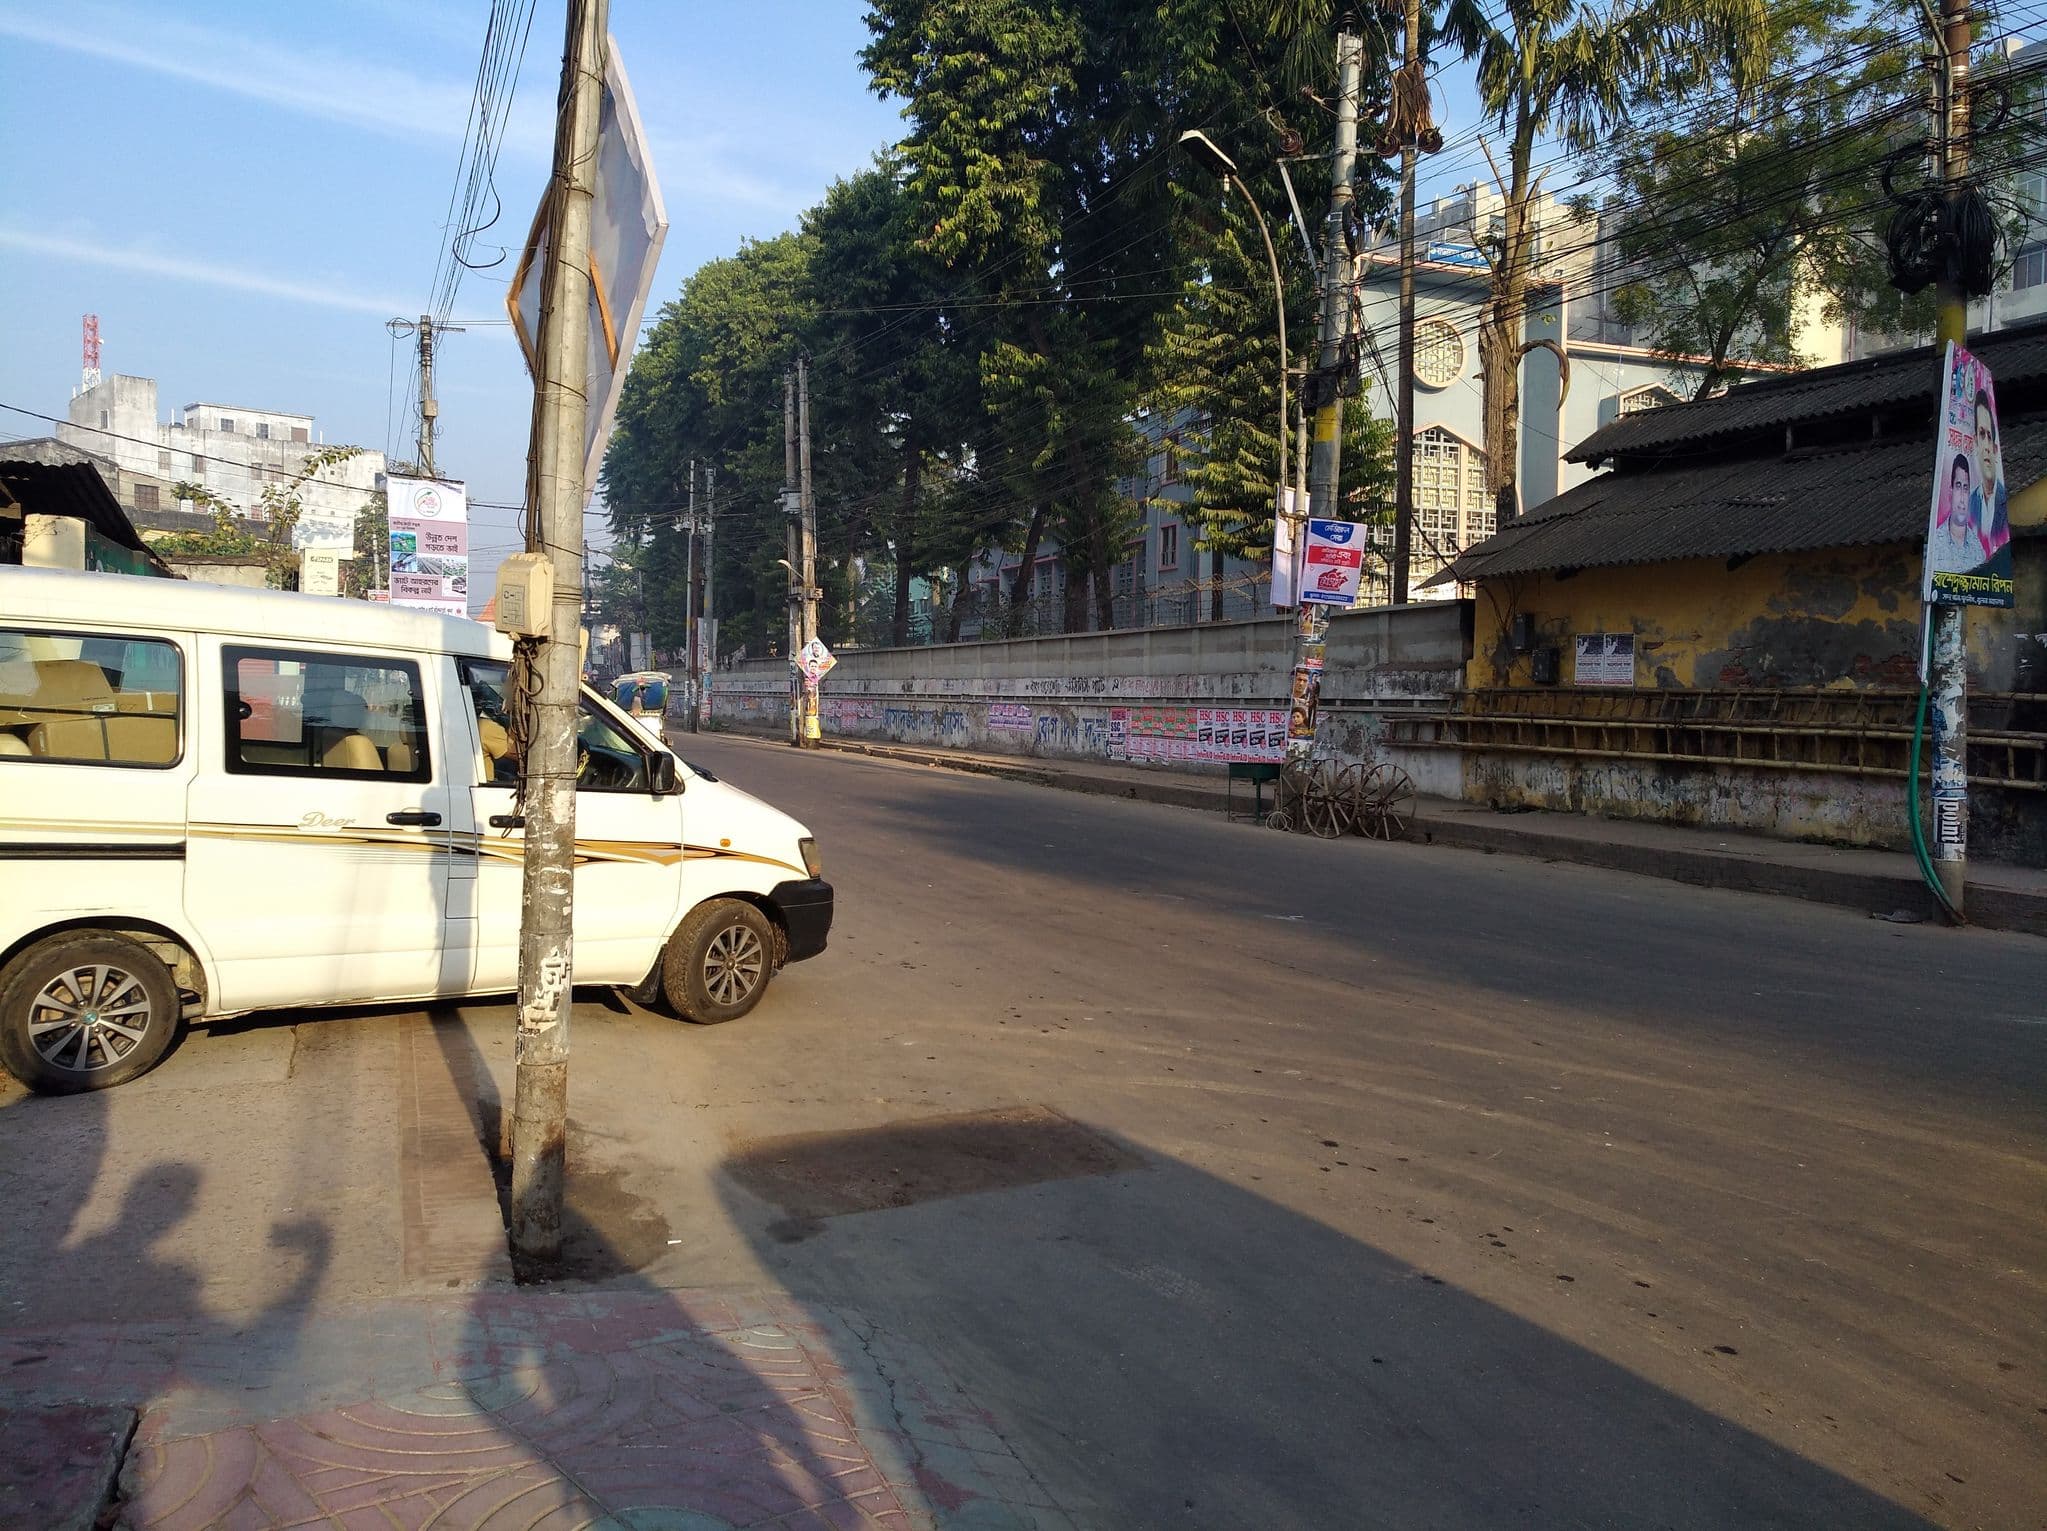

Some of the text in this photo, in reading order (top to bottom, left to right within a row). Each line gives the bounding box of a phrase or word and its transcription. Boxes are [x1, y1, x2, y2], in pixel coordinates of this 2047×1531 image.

[1991, 572, 2014, 594] রিপন
[1199, 710, 1213, 721] HSC
[1215, 711, 1230, 722] HSC
[1232, 711, 1247, 722] HSC
[1250, 712, 1266, 723] HSC
[1269, 712, 1286, 724] HSC
[1110, 721, 1121, 732] SSC
[301, 811, 357, 828] Deer
[1938, 799, 1960, 842] point
